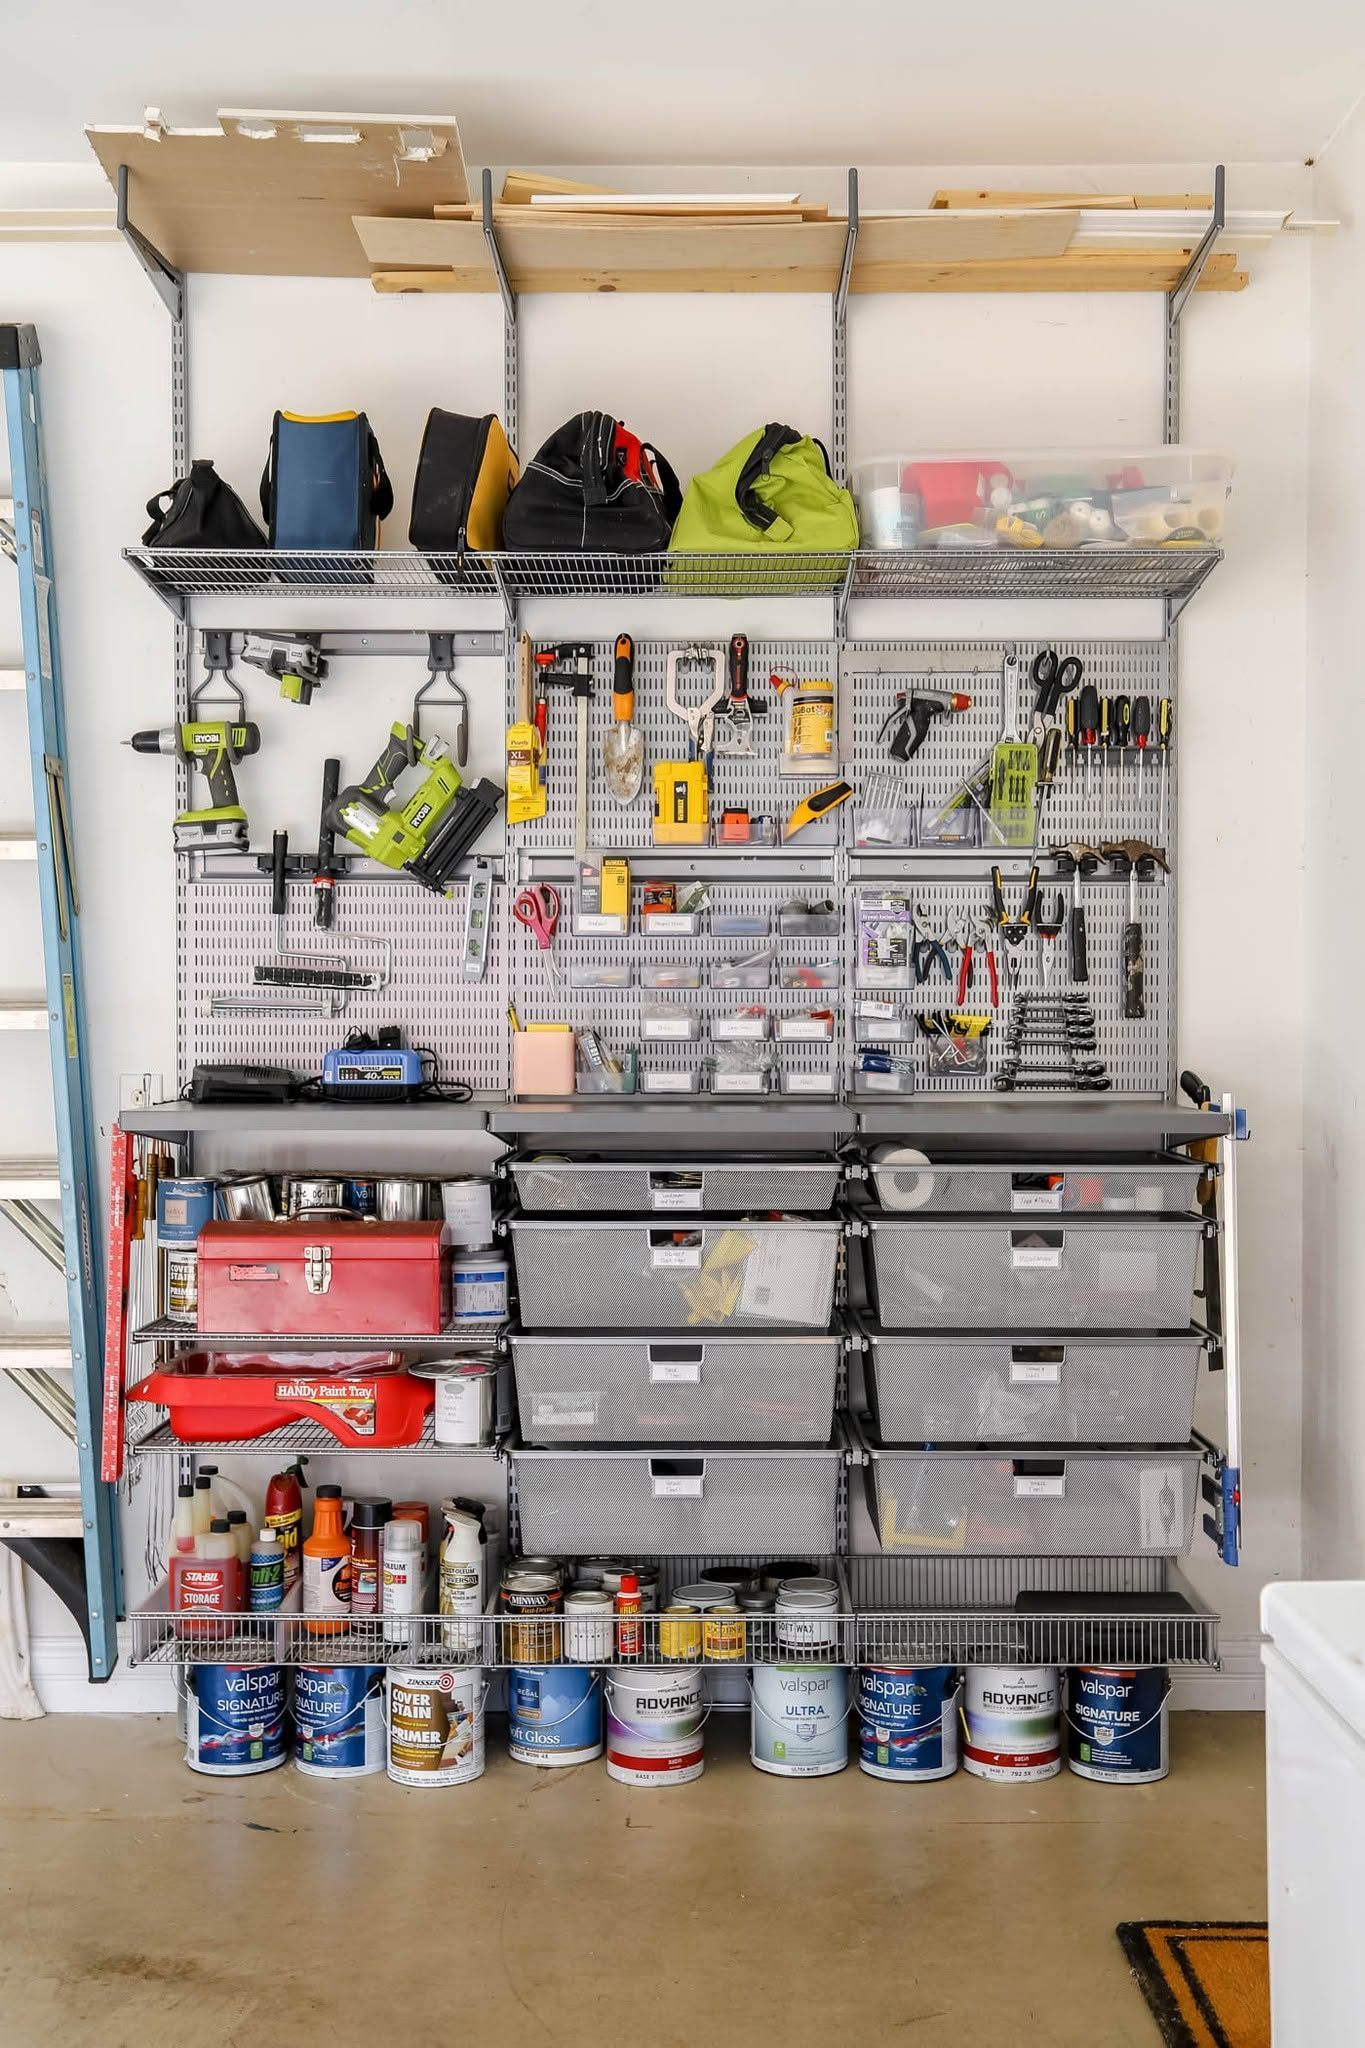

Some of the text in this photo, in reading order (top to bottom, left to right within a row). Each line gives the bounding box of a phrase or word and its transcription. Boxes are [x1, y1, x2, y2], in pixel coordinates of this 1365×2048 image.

[194, 734, 219, 743] RYOBI
[511, 751, 525, 759] XL
[411, 804, 431, 827] RYOBI
[81, 1208, 90, 1283] WERNER
[170, 1264, 196, 1273] COVER
[170, 1287, 197, 1296] PRIME
[278, 1385, 372, 1399] HANDy Paint Tray
[384, 1562, 406, 1570] OLEUM
[185, 1572, 219, 1581] STA-BIL
[184, 1593, 220, 1604] STORAGE
[511, 1596, 546, 1605] MINWAX
[795, 1624, 814, 1633] WAX
[225, 1672, 280, 1693] valspar
[295, 1672, 337, 1696] alspar
[406, 1678, 440, 1686] ZINSSER
[780, 1677, 830, 1695] valspar
[861, 1674, 915, 1699] valspar
[1081, 1679, 1133, 1700] valspar
[217, 1690, 284, 1711] SIGNATURE
[392, 1688, 431, 1706] COVER
[517, 1688, 539, 1698] REGAL
[636, 1690, 703, 1710] ADVANCE
[983, 1689, 1054, 1705] ADVANCE
[391, 1702, 432, 1719] STAIN
[786, 1705, 825, 1716] ULTRA
[1075, 1703, 1140, 1722] SIGNATURE
[391, 1725, 442, 1743] PRIMER
[511, 1727, 560, 1744] oft Gloss
